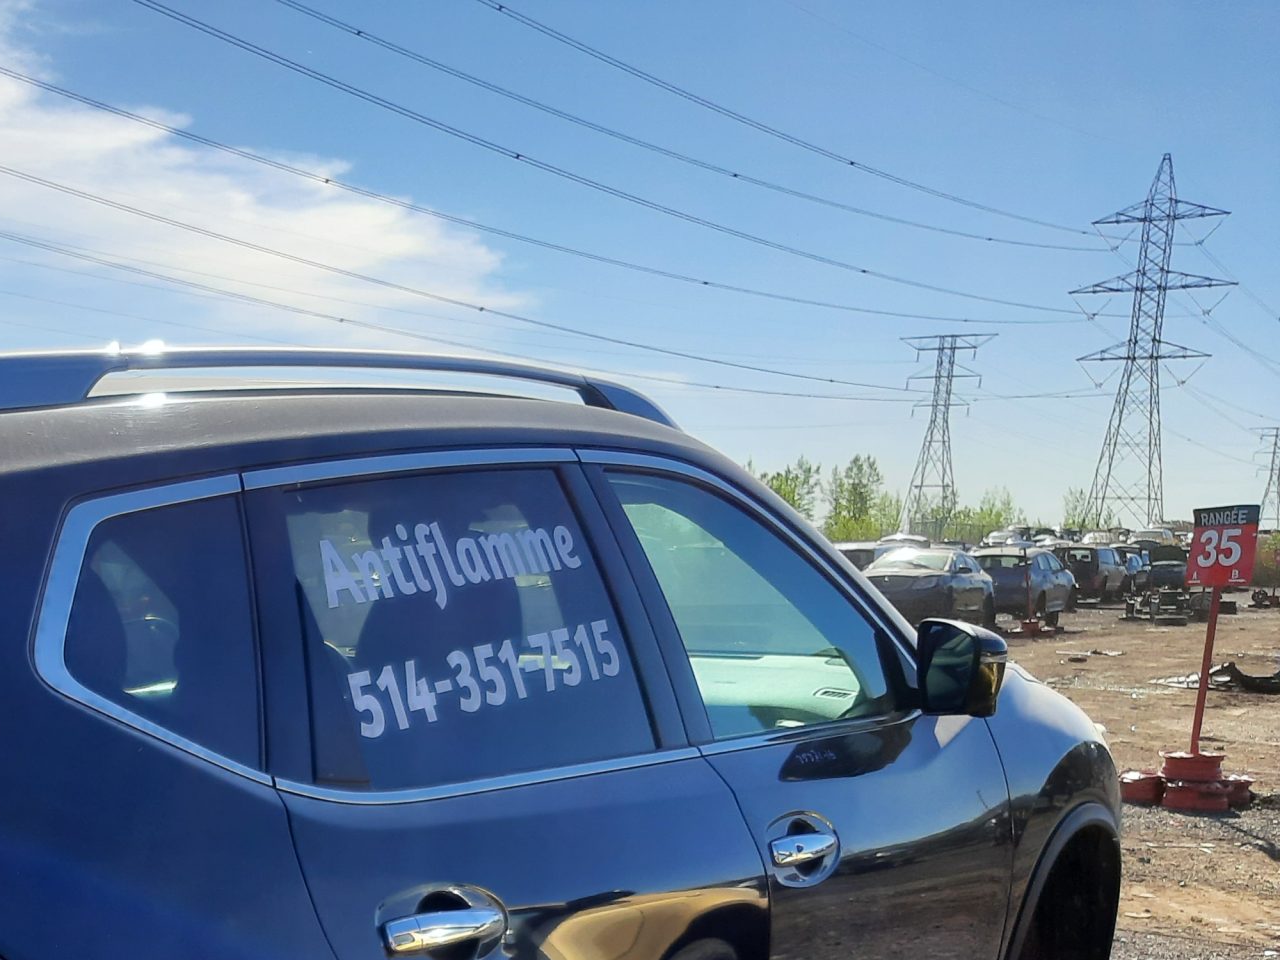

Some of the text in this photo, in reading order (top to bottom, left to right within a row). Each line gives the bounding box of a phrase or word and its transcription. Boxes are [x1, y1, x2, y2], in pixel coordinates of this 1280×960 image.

[1200, 508, 1248, 526] RANGÉE
[320, 521, 582, 610] Antiflamme
[1197, 528, 1242, 568] 35
[1231, 570, 1239, 579] B
[347, 619, 620, 738] 514-351-7515
